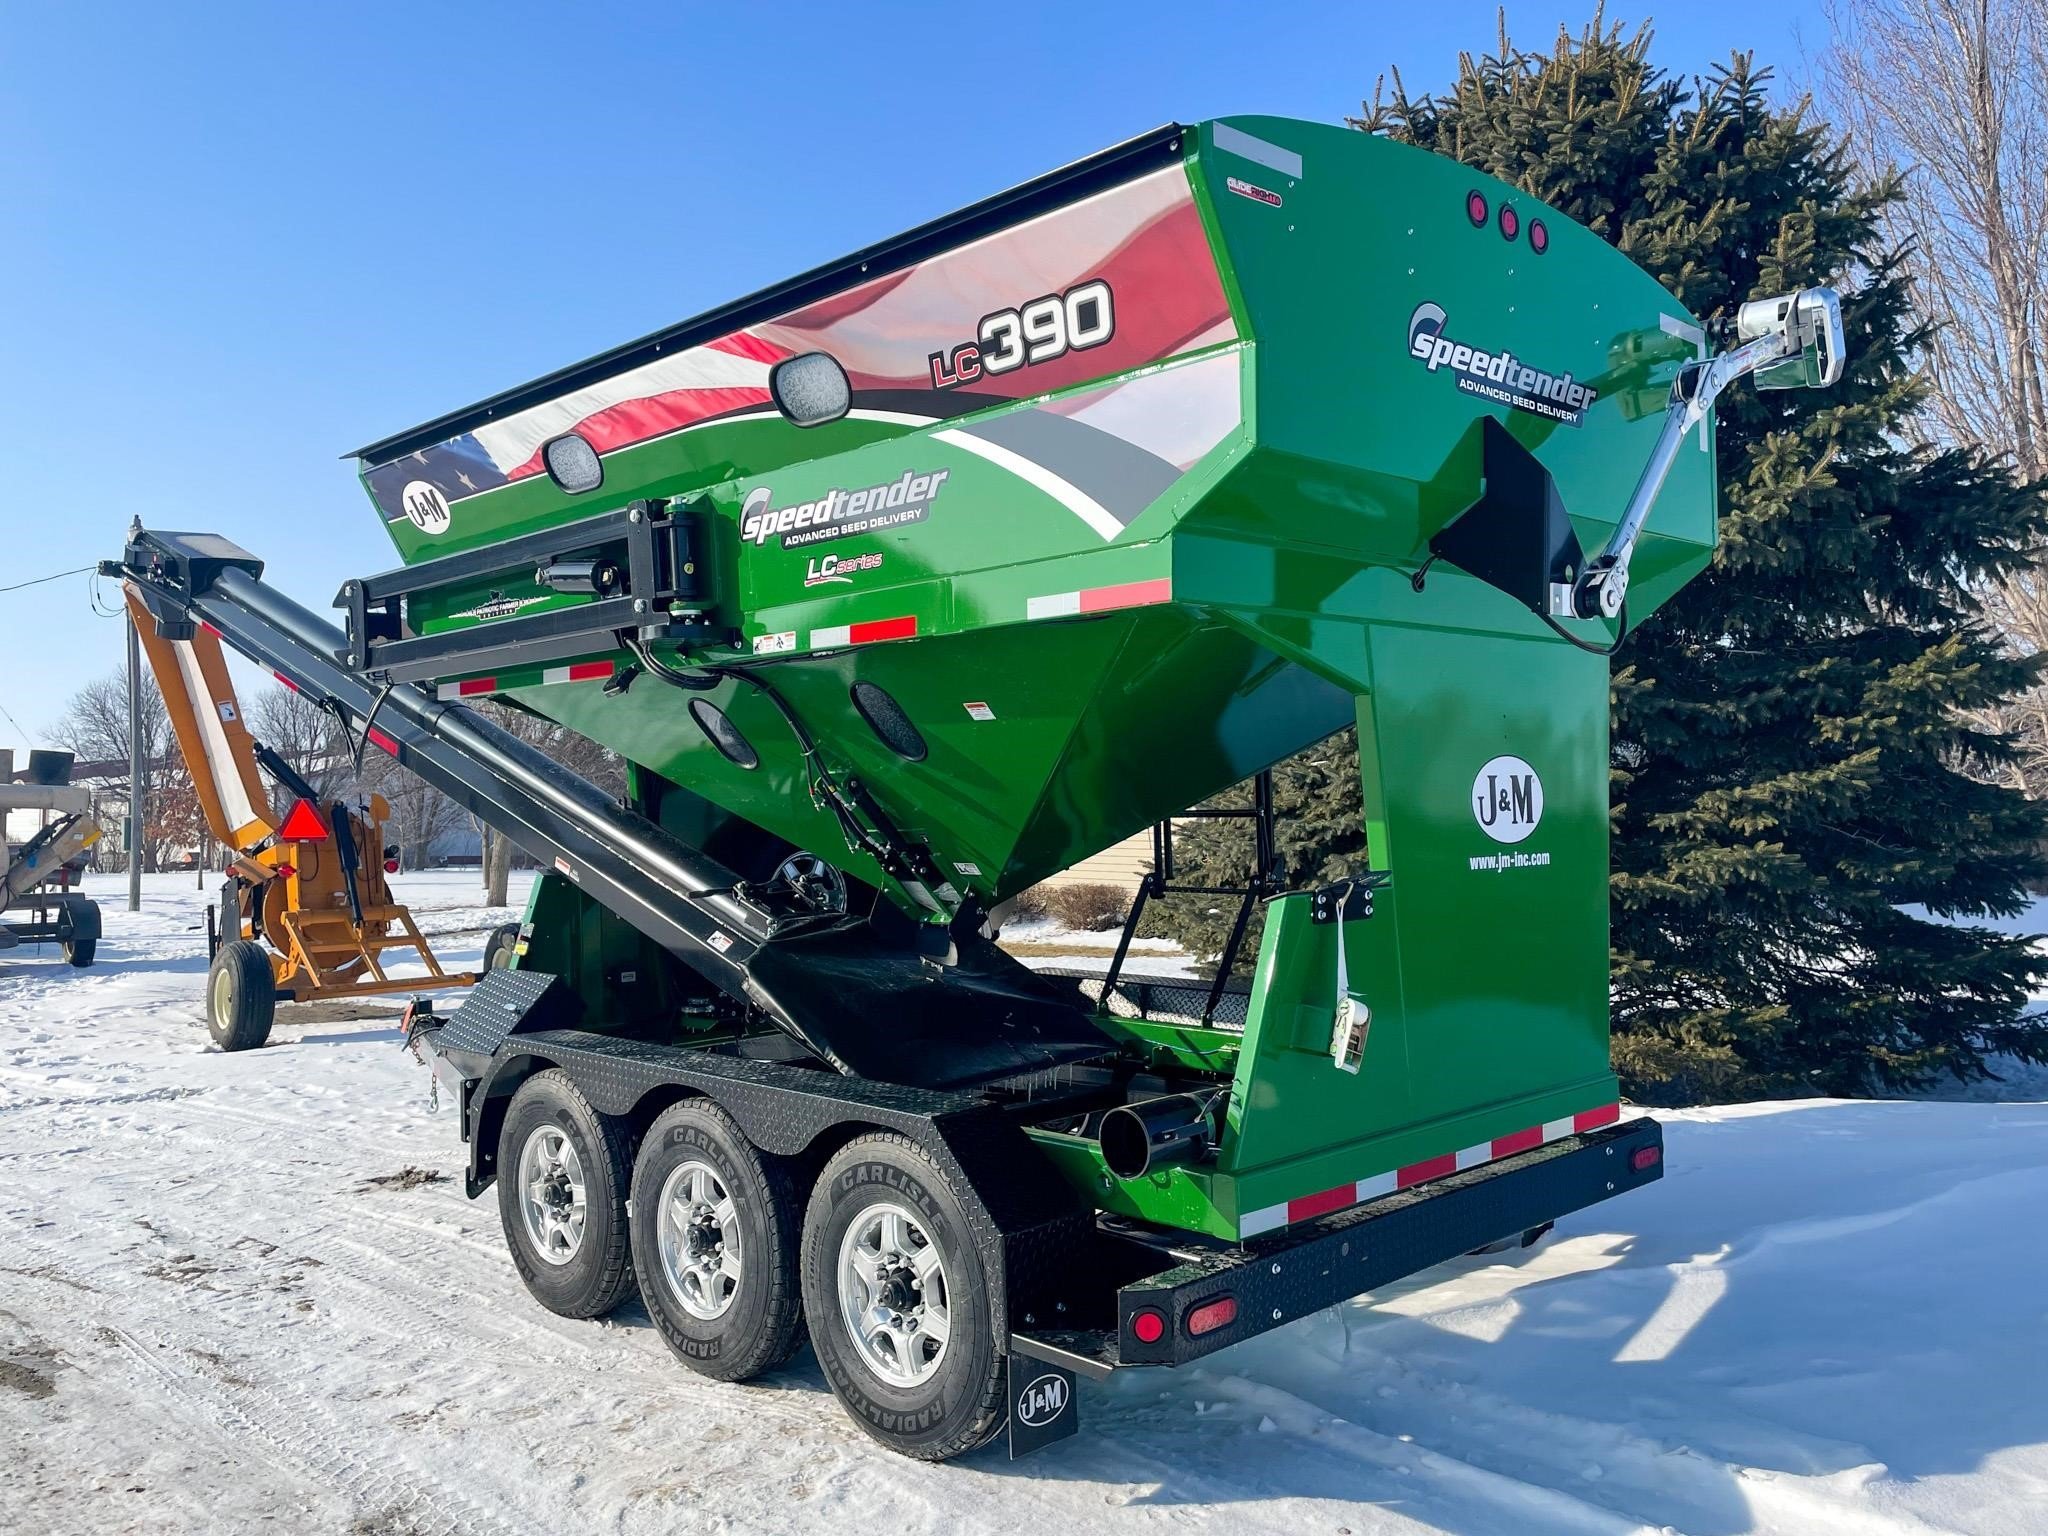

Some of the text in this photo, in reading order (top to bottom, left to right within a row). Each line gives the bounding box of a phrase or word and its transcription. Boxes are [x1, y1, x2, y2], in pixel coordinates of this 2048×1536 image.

[1459, 378, 1578, 423] ADVANCED SEED DELIVERY
[408, 488, 448, 527] J&M
[784, 508, 922, 547] ADVANCED SEED DELIVERY
[1477, 774, 1535, 827] J&M
[1469, 851, 1551, 873] www.jm-inc.com
[674, 1127, 749, 1214] CARLISLE
[841, 1164, 948, 1236] CARLISLE
[1021, 1379, 1062, 1420] J&M
